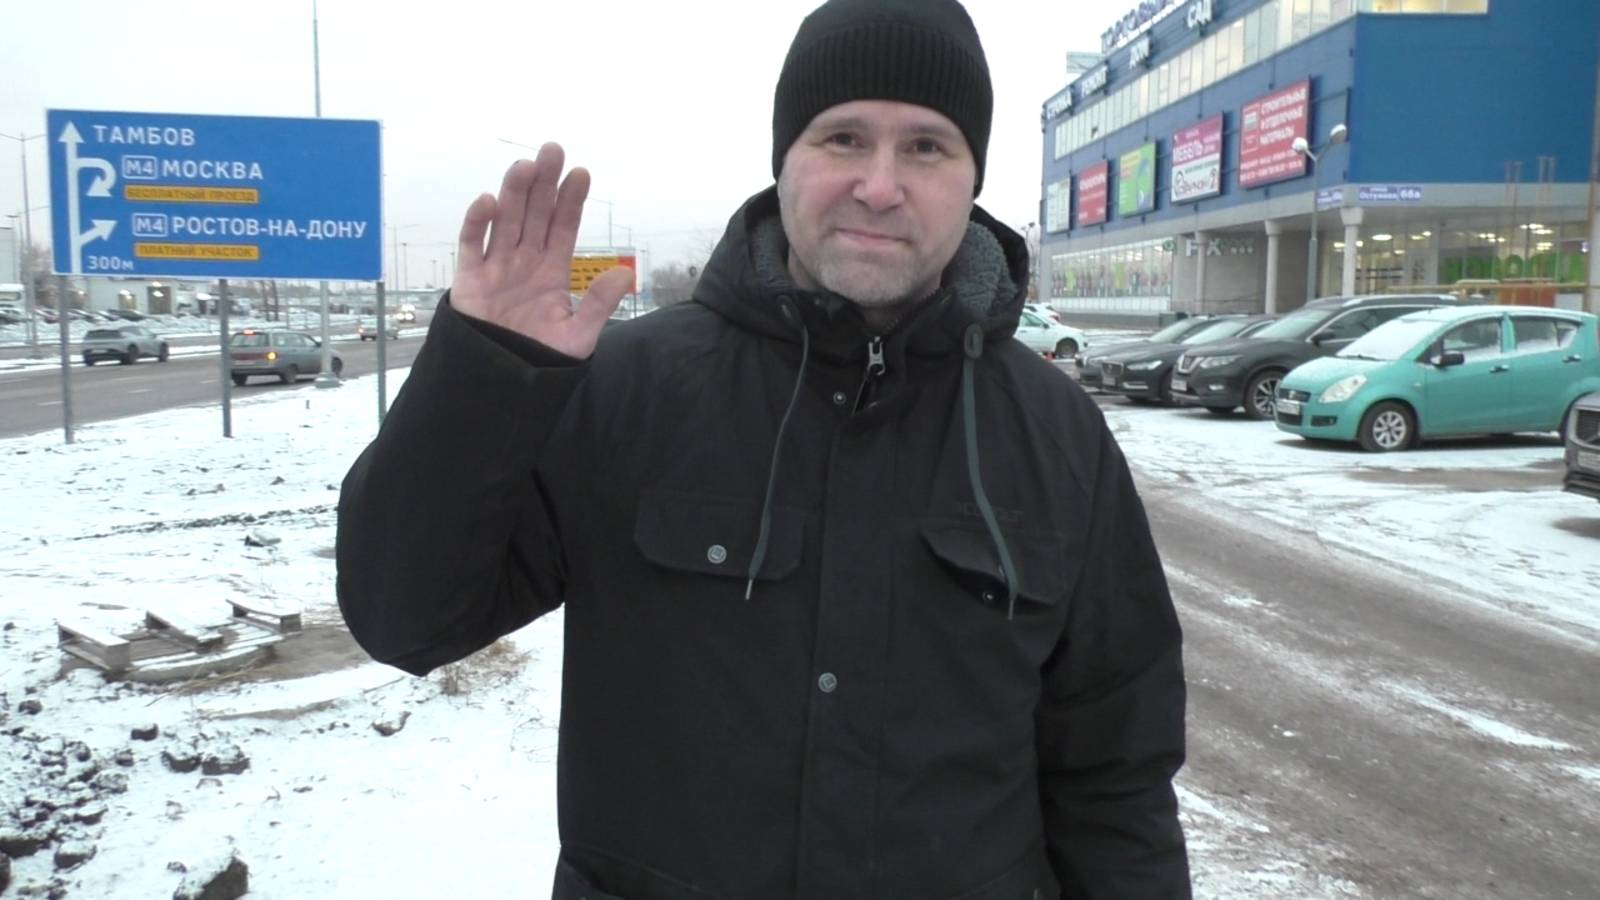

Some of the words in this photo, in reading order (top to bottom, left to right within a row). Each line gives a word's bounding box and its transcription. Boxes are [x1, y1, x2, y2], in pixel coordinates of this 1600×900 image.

[93, 124, 196, 146] ТАМБОВ
[162, 159, 264, 180] МОСКВА
[172, 216, 367, 240] РОСТОВ-НА-ДОНУ
